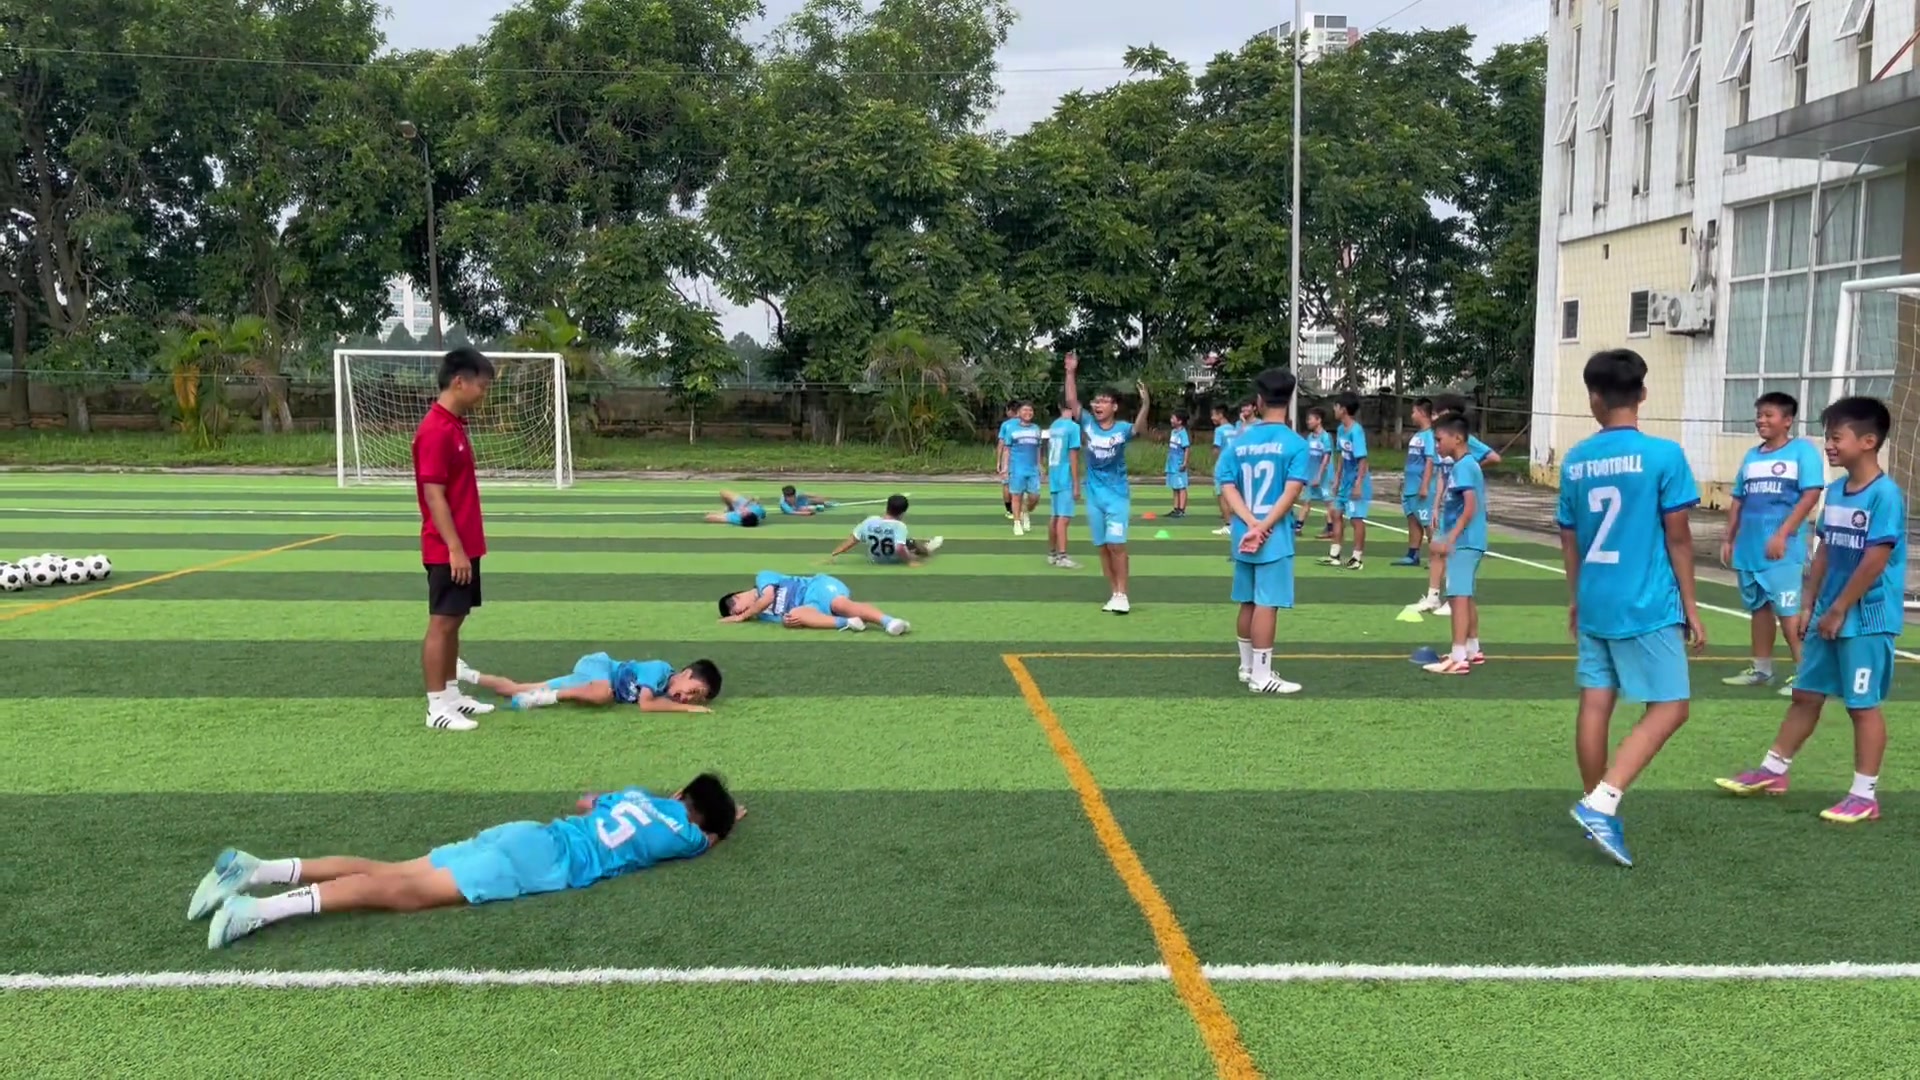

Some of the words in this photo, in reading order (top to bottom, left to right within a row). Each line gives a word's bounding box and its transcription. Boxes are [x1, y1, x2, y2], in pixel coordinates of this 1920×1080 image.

[1586, 454, 1644, 478] FOOTBALL
[1240, 459, 1275, 514] 12
[1584, 485, 1622, 565] 2
[868, 534, 895, 557] 26
[1779, 591, 1797, 608] 12
[1853, 667, 1872, 694] 8
[595, 800, 653, 849] 5
